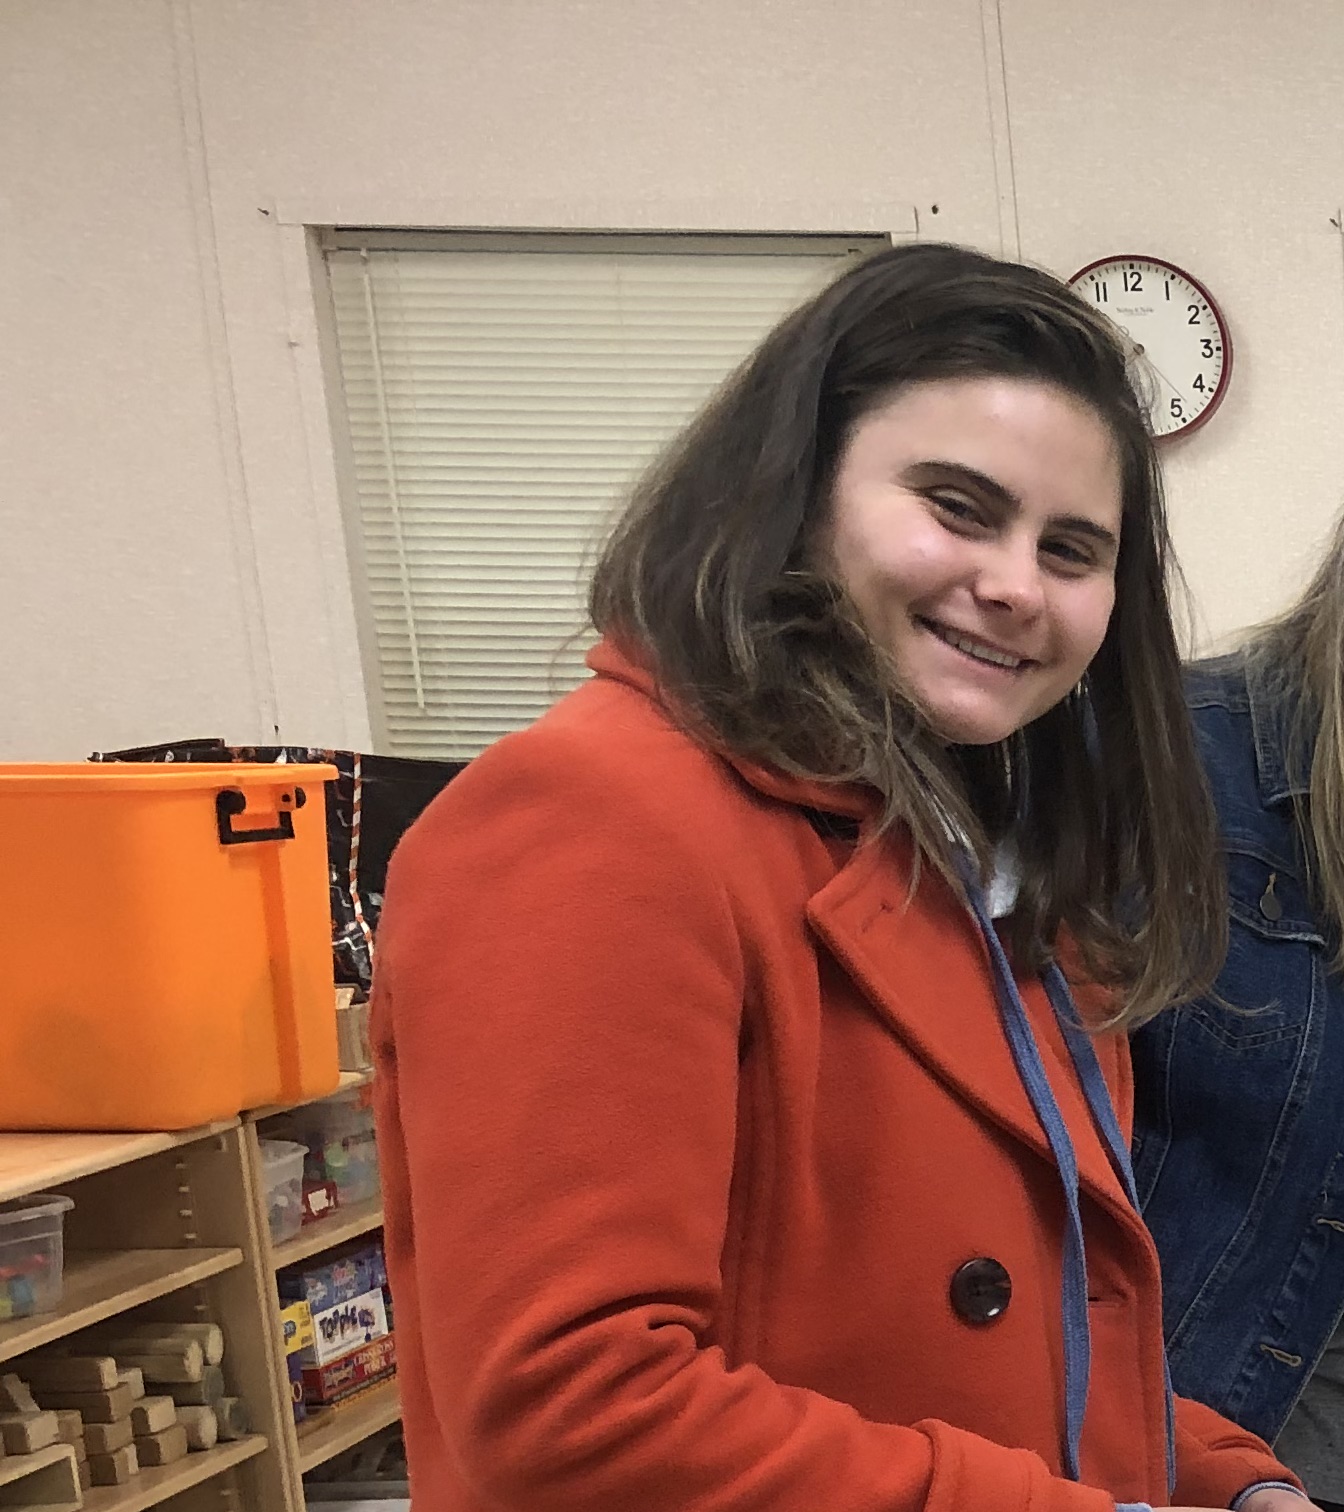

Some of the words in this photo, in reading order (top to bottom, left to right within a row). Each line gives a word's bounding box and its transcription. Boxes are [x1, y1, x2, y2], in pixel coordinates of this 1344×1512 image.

[1123, 272, 1143, 292] 12
[1165, 281, 1170, 300] 1
[1095, 282, 1108, 302] 11
[1187, 305, 1200, 324] 2
[1200, 339, 1214, 359] 3
[1193, 374, 1206, 392] 4
[1170, 399, 1182, 418] 5
